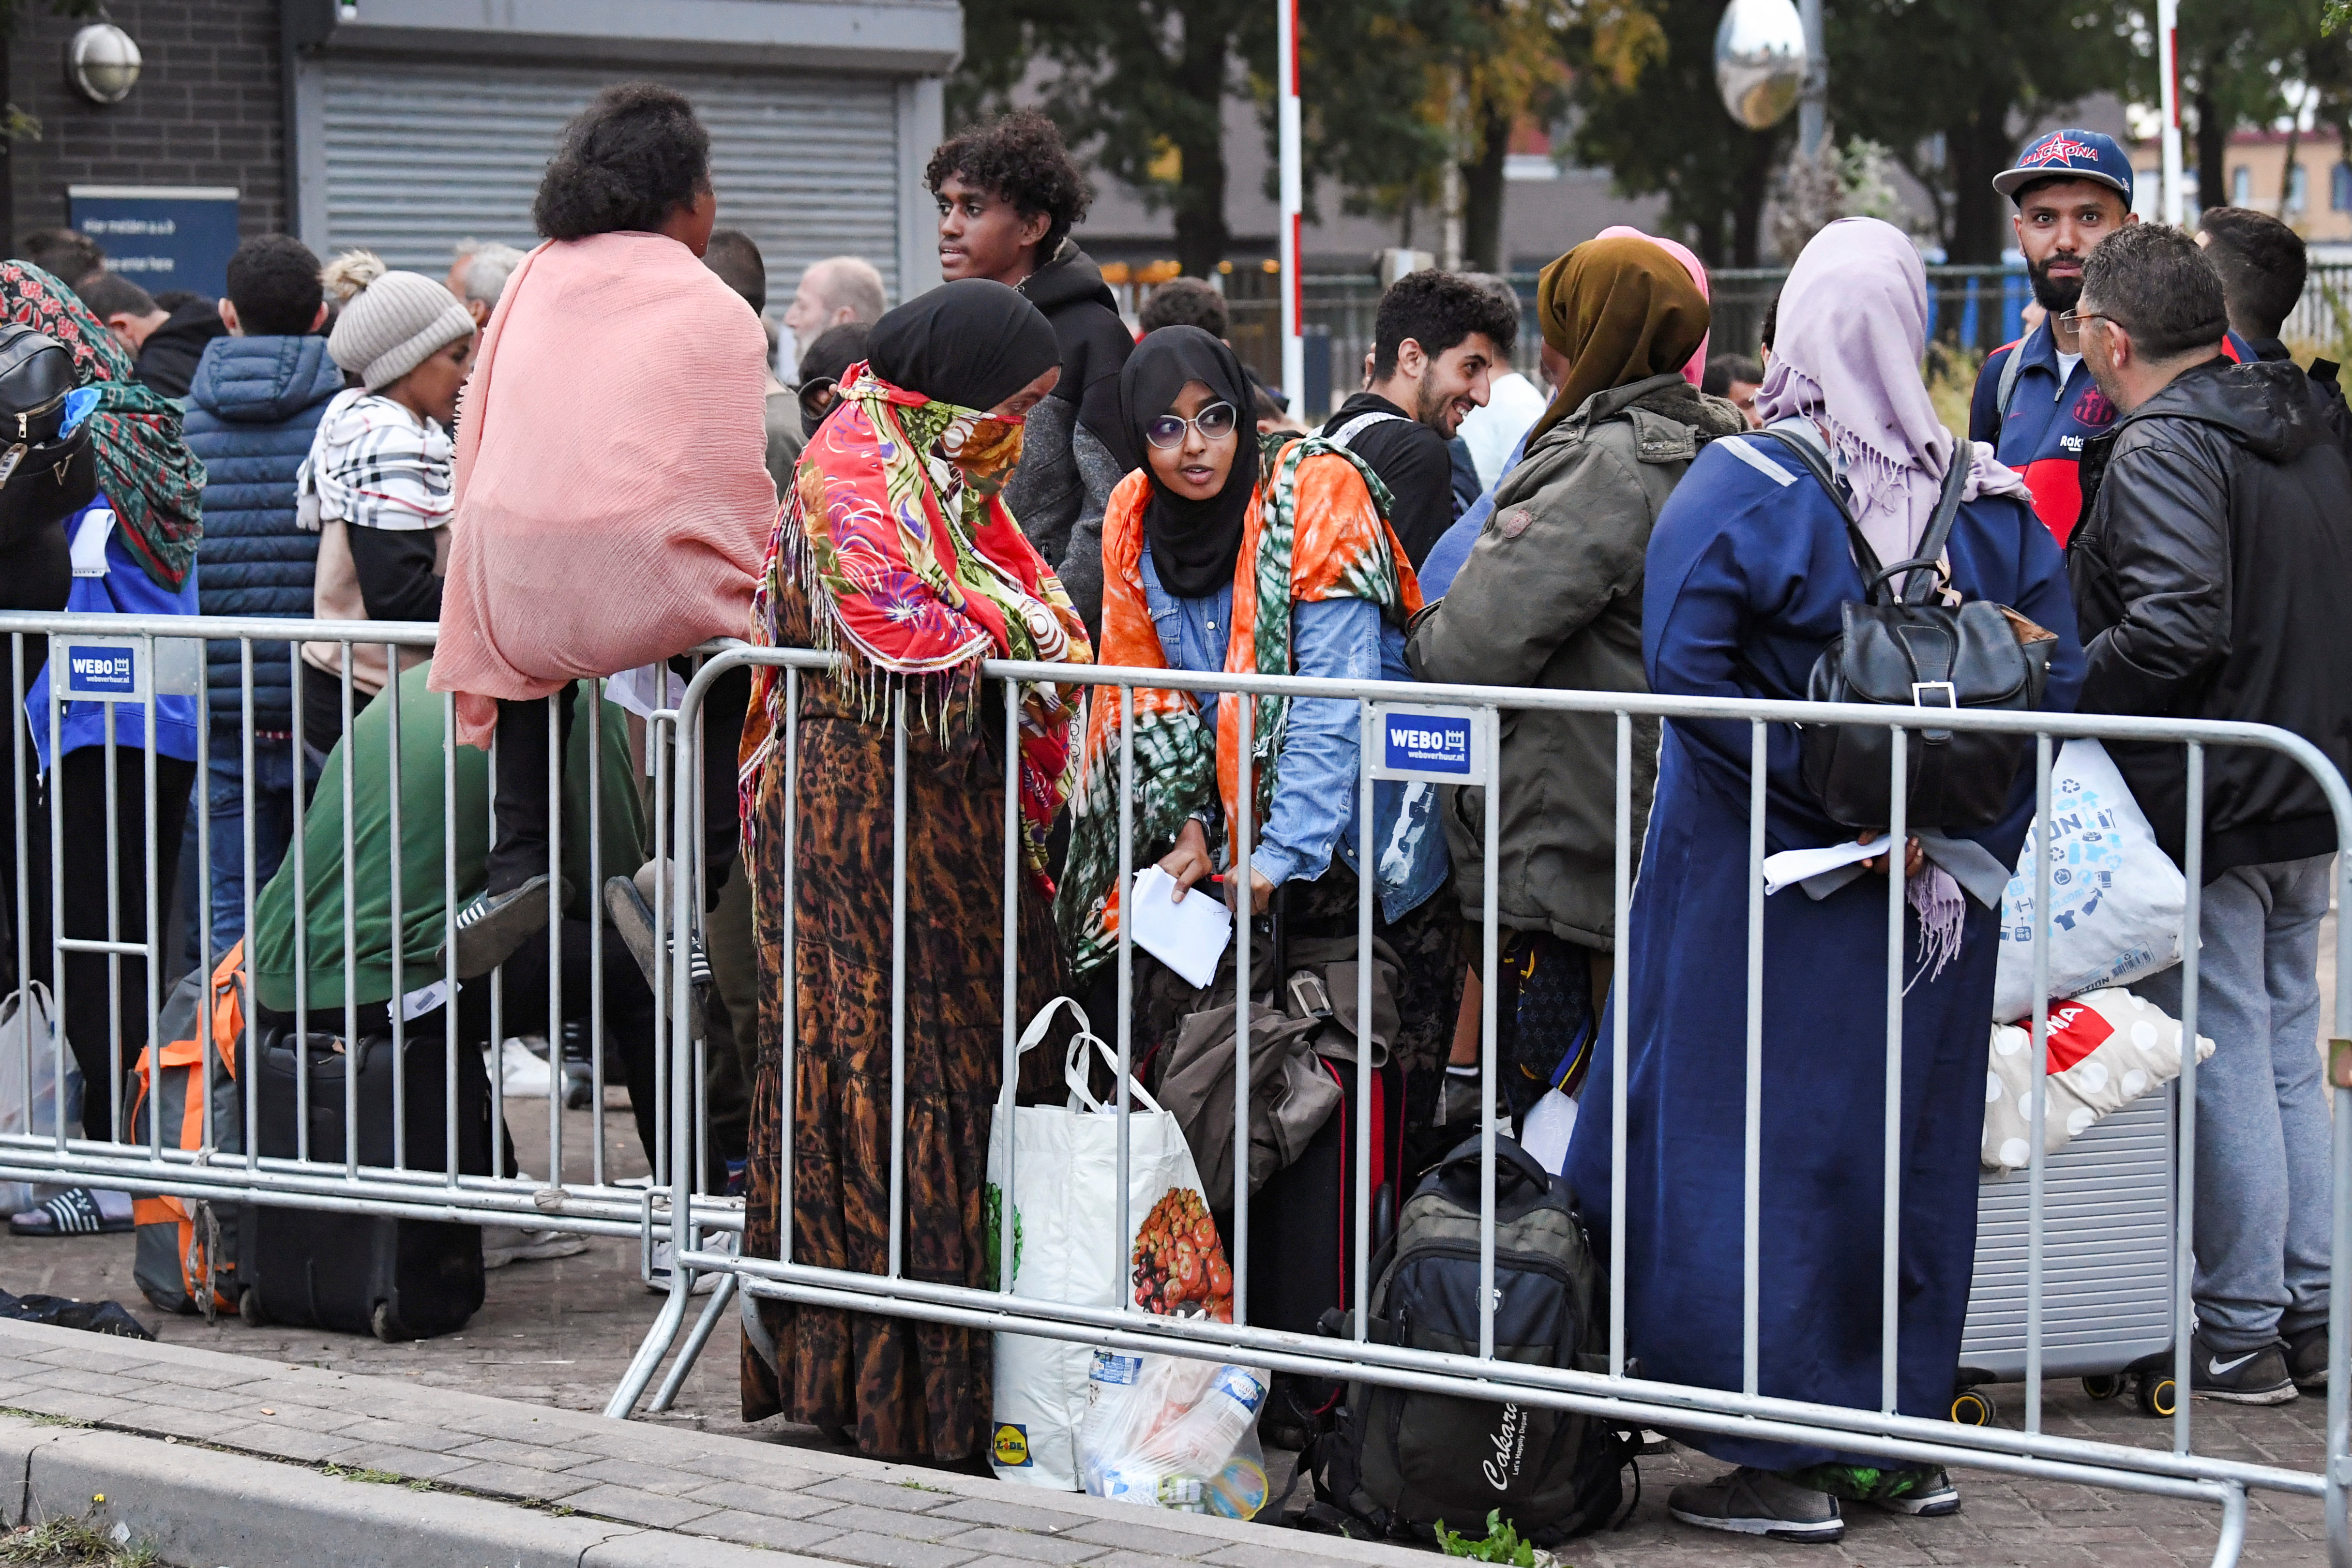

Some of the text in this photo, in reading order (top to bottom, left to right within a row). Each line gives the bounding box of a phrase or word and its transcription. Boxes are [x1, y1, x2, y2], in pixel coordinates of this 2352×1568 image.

[2020, 144, 2098, 167] BARCEONA
[72, 658, 112, 675] WEBO
[86, 675, 130, 683] weboverhuur.nl
[1390, 728, 1443, 750] WEBO
[1408, 750, 1465, 762] weboverhuur.nl
[2046, 1008, 2084, 1037] MA
[1519, 1412, 1528, 1433] Depart
[1515, 1434, 1525, 1459] Happily
